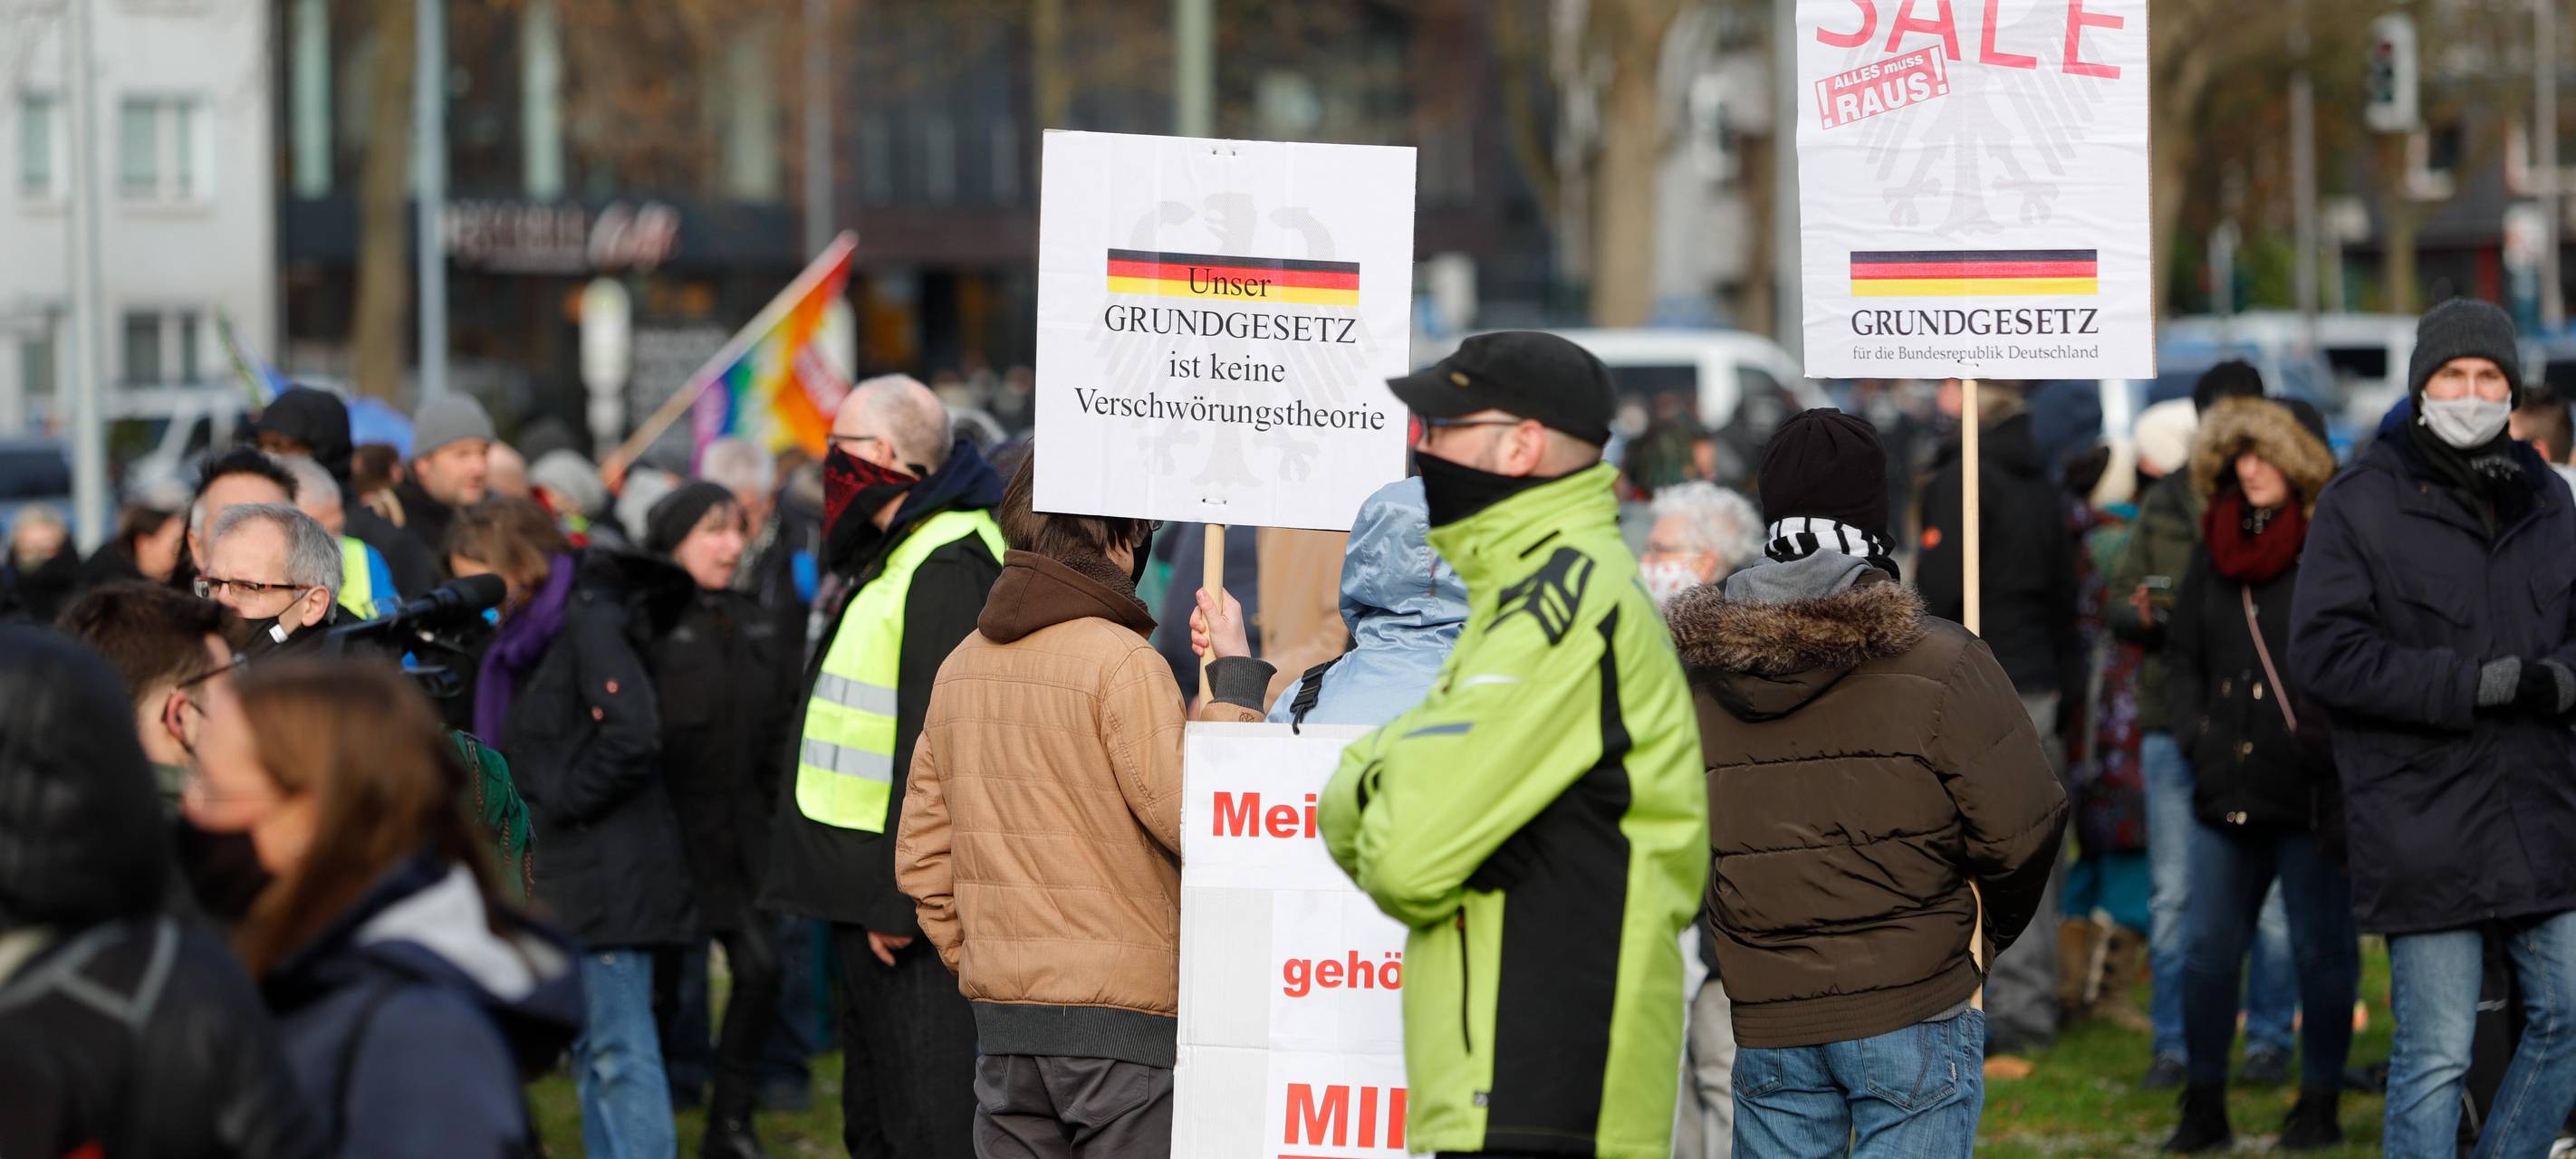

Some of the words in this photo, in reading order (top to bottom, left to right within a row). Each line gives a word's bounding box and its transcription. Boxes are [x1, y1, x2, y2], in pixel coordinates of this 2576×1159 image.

[1833, 64, 1880, 91] ALLES
[1884, 54, 1924, 75] muss
[1188, 268, 1271, 297] Unser
[1104, 305, 1356, 344] GRUNDGESETZ
[1851, 309, 2099, 336] GRUNDGESETZ
[1169, 350, 1201, 379] ist
[1209, 353, 1286, 384] keine
[1852, 346, 1871, 360] für
[1875, 346, 1895, 359] die
[1898, 346, 2004, 361] Bundesrepublik
[2008, 345, 2099, 359] Deutschland
[1074, 388, 1386, 432] Verschwörungstheorie
